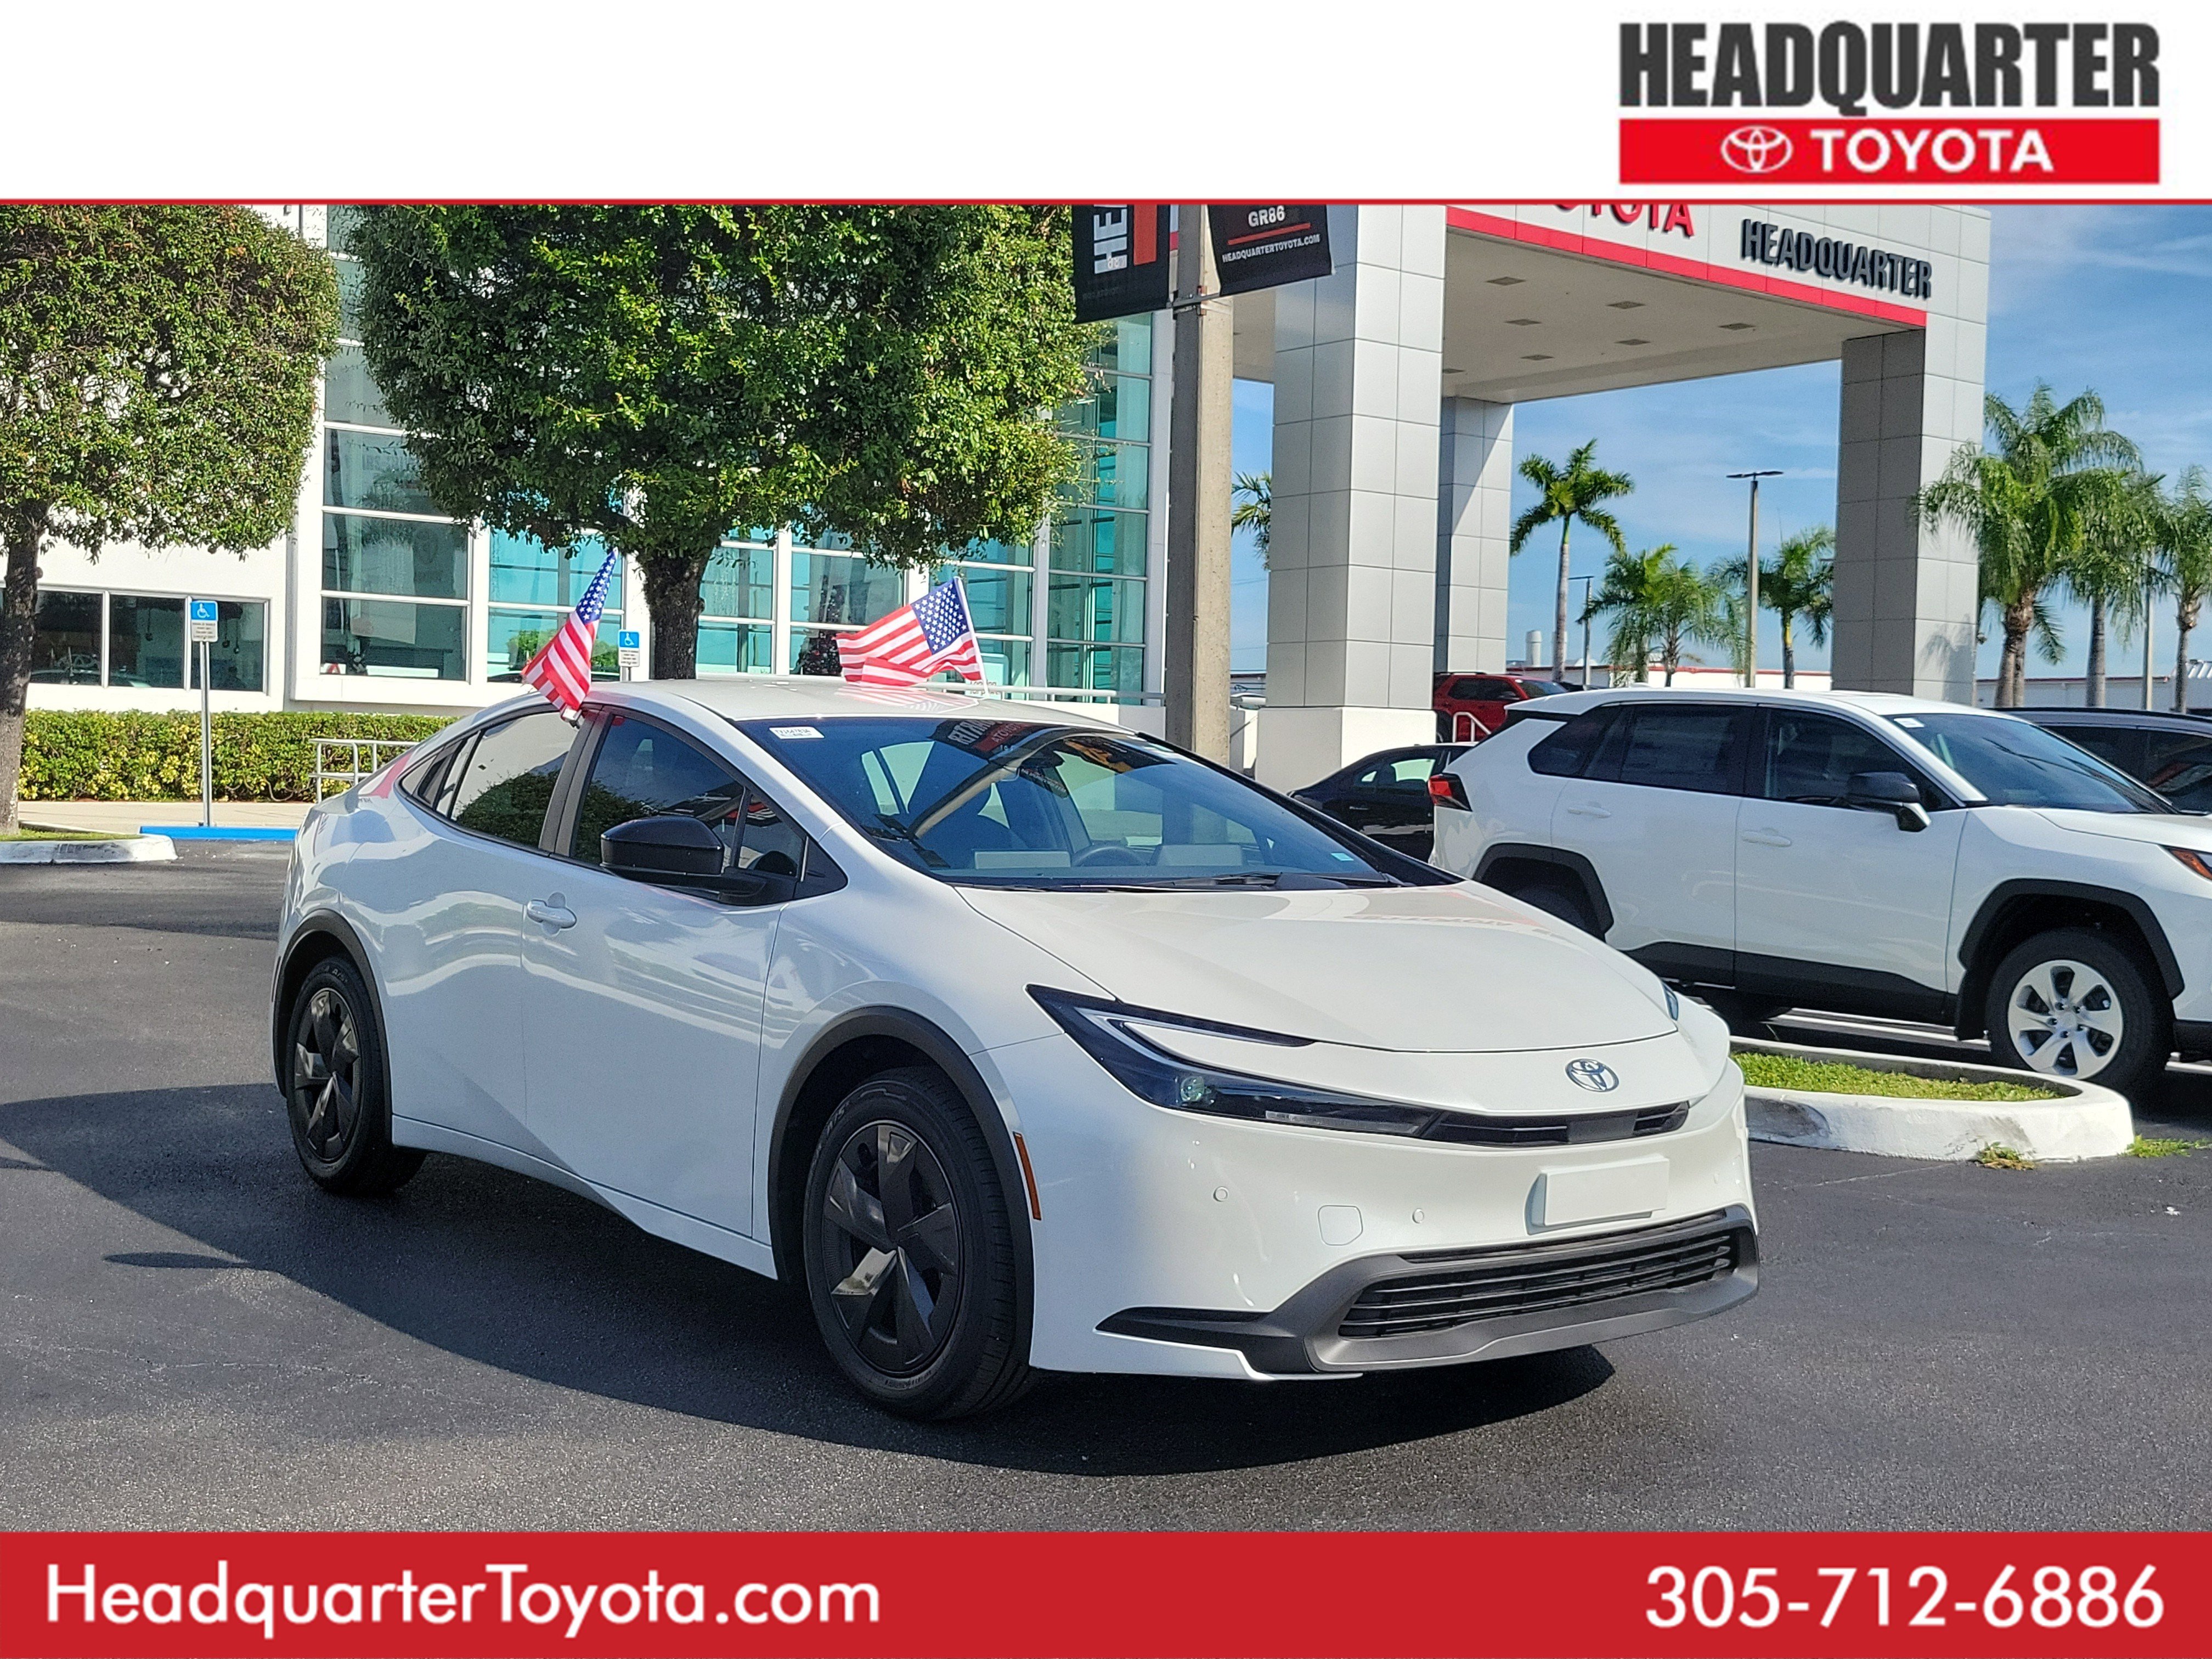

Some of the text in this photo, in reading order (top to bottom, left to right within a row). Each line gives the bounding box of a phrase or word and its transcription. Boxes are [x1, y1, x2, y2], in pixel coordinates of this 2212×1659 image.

[1094, 205, 1127, 274] HE
[1248, 205, 1285, 227] GR86
[1222, 234, 1321, 263] HEADQUARTERTOYOTA.COM
[1741, 219, 1932, 300] HEADQUARTER
